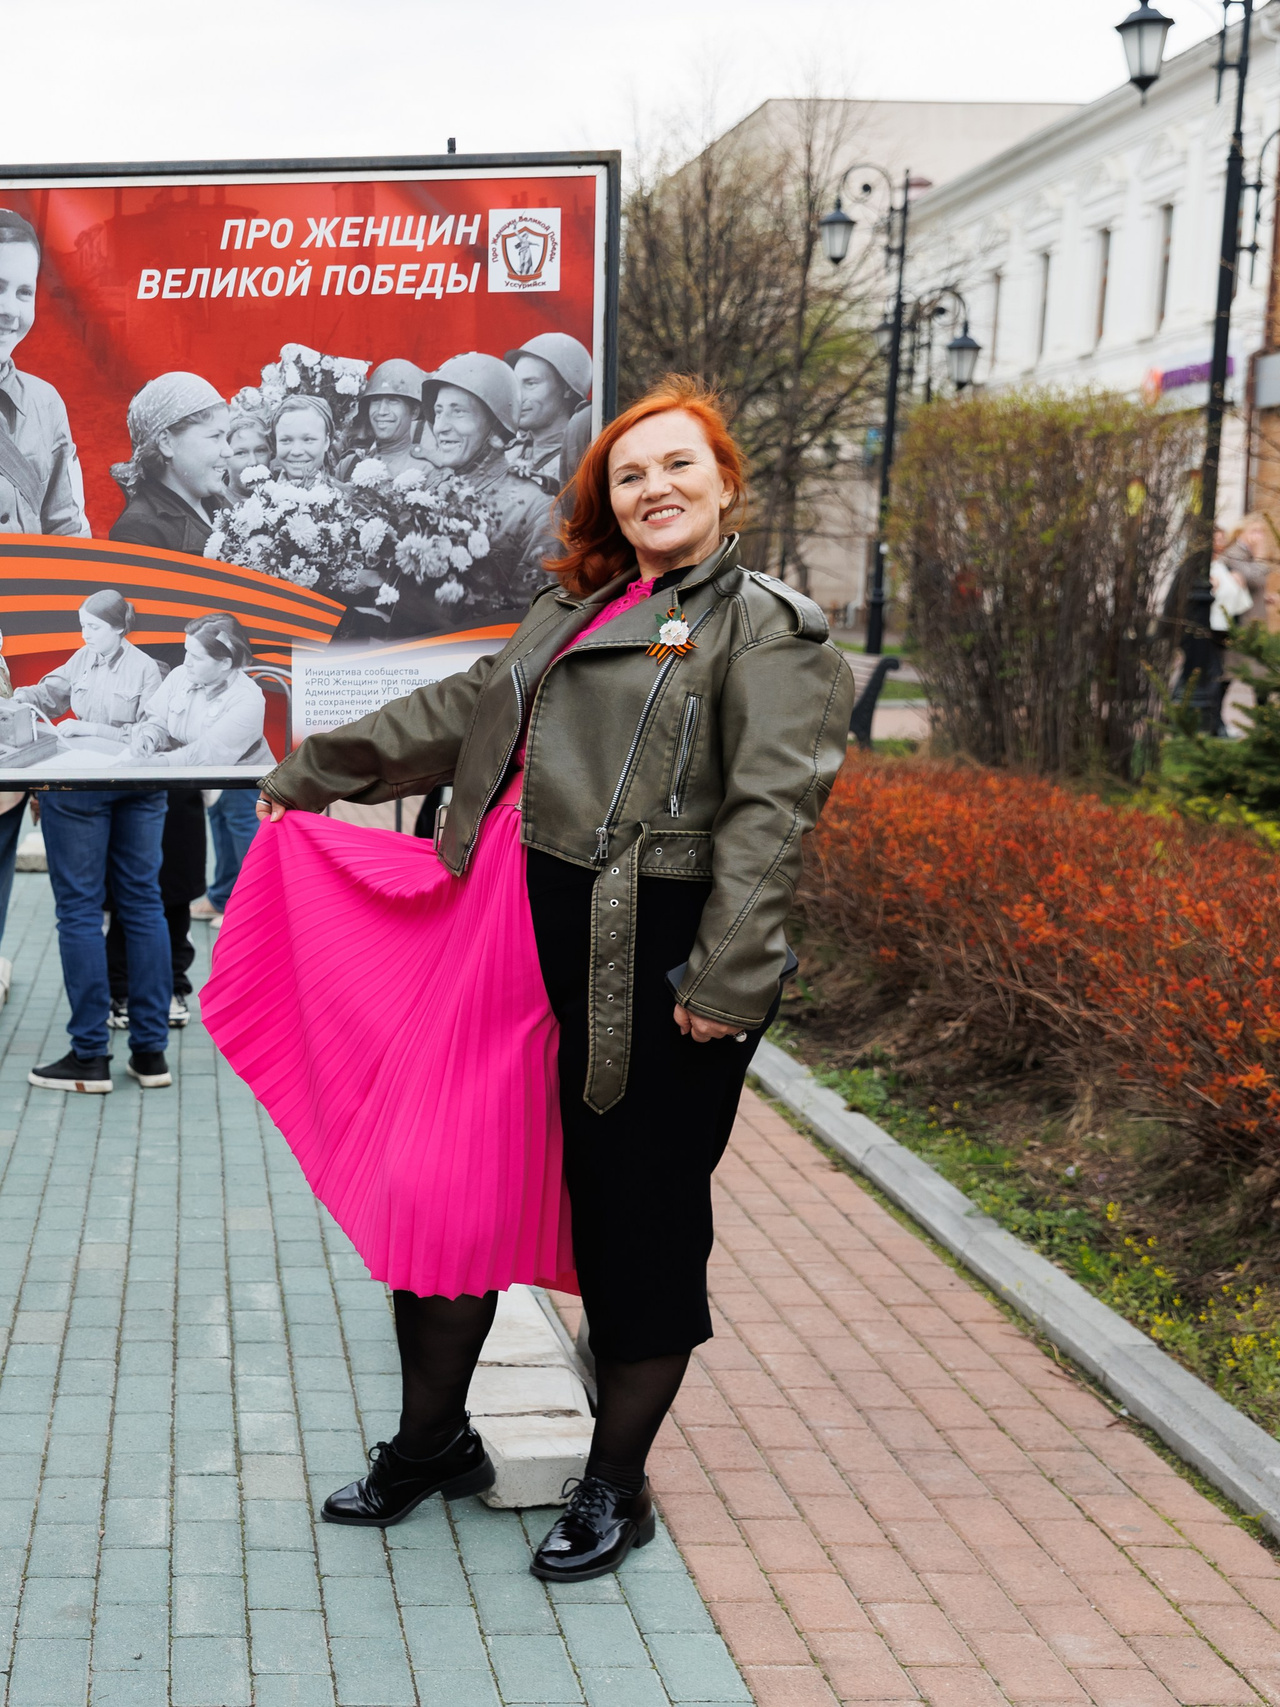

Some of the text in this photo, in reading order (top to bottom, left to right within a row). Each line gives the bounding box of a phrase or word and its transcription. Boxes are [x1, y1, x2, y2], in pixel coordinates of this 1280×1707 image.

[518, 216, 551, 232] Великой
[220, 214, 481, 252] ПРО ЖЕНЩИН
[137, 259, 480, 300] ВЕЛИКОЙ ПОБЕДЫ
[305, 668, 419, 677] Инициатива сообщества
[305, 678, 330, 686] «PRO
[333, 678, 378, 686] Женщин»
[305, 688, 378, 696] Администрации
[382, 688, 401, 696] УГО,
[306, 718, 344, 726] Великой
